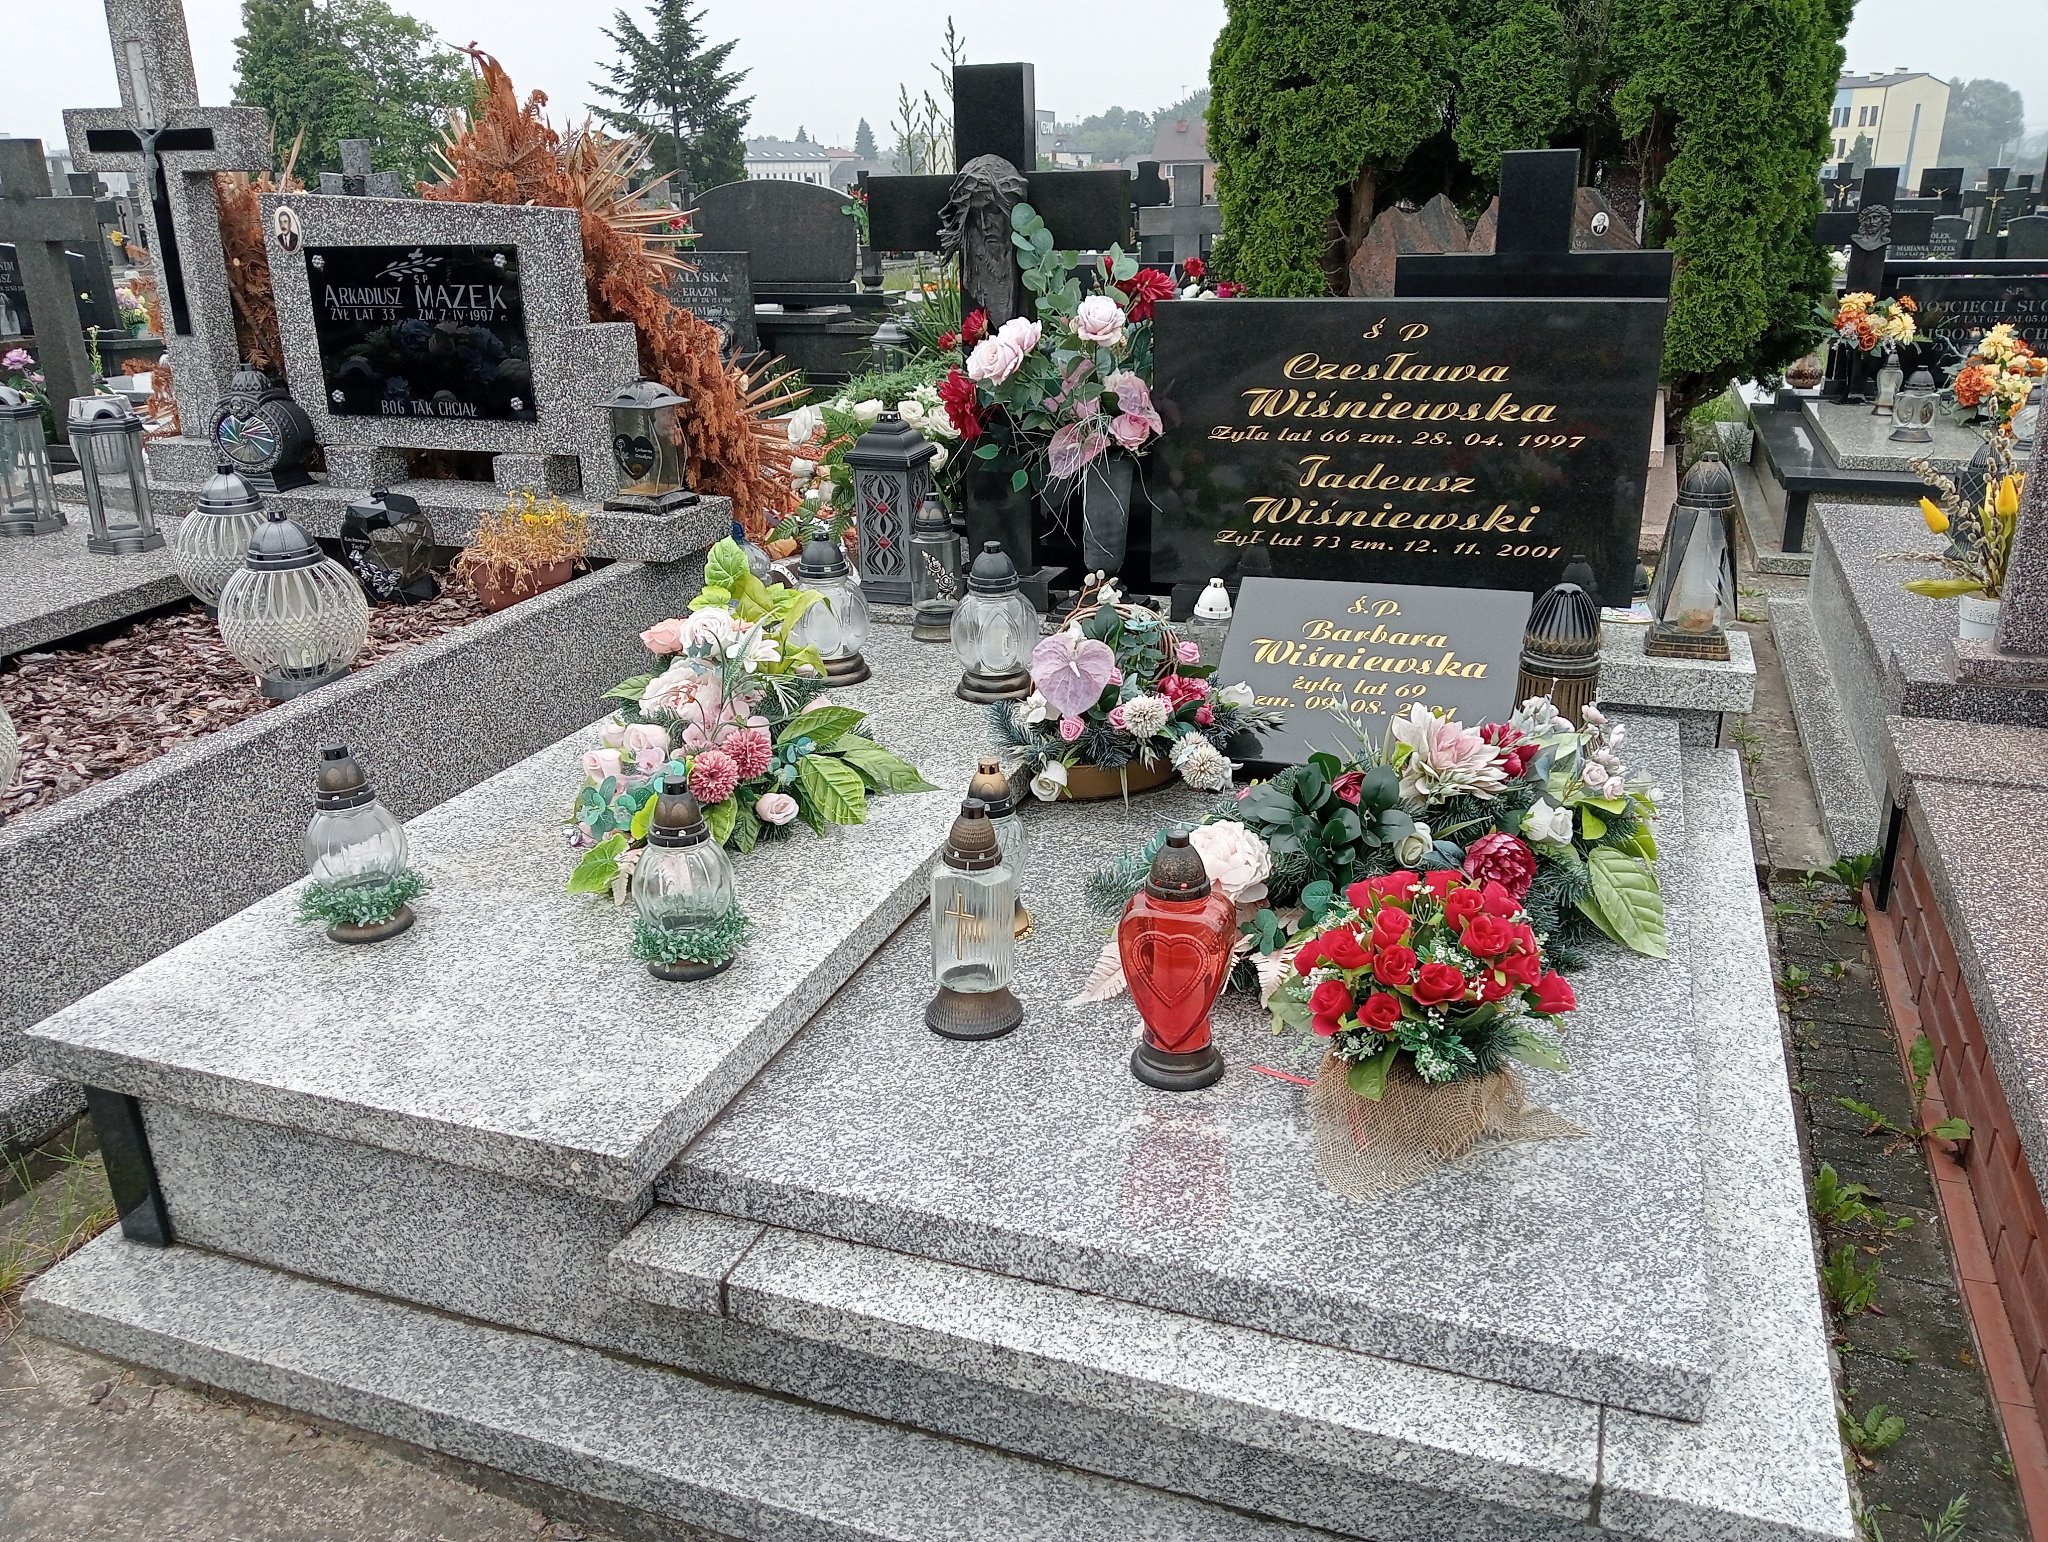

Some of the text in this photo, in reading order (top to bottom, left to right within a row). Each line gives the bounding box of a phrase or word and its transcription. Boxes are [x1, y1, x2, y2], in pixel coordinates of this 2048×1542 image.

[324, 284, 507, 309] ARKADIUSZ MAZEK
[682, 287, 718, 297] ERAZM
[354, 308, 374, 321] LAT
[381, 308, 396, 321] 33
[1362, 317, 1429, 342] Ś P
[1283, 352, 1510, 382] Czesława
[410, 399, 435, 416] TAK
[438, 401, 479, 417] CHCIAŁ
[1240, 387, 1557, 423] Wiśniewska
[1277, 427, 1313, 442] lat
[1320, 428, 1351, 443] 66
[1358, 432, 1403, 444] zm.
[1411, 431, 1452, 445] 28.
[1464, 432, 1504, 447] 04.
[1517, 434, 1586, 449] 1997
[1299, 454, 1475, 493] Tadeusz
[1243, 495, 1541, 533] Wiśniewski
[1269, 532, 1303, 547] lat
[1312, 535, 1341, 549] 73
[1350, 539, 1394, 551] zm.
[1403, 539, 1438, 553] 12.
[1453, 542, 1481, 555] 11.
[1496, 543, 1562, 559] 2001
[1347, 595, 1402, 618] Ś.P.
[1302, 619, 1449, 648] Barbara
[1249, 638, 1489, 679] Wiśniewska
[1292, 675, 1428, 699] żyła lat 69
[1254, 695, 1296, 708] zm.
[1350, 699, 1387, 715] 08.
[1394, 702, 1458, 721] 21
